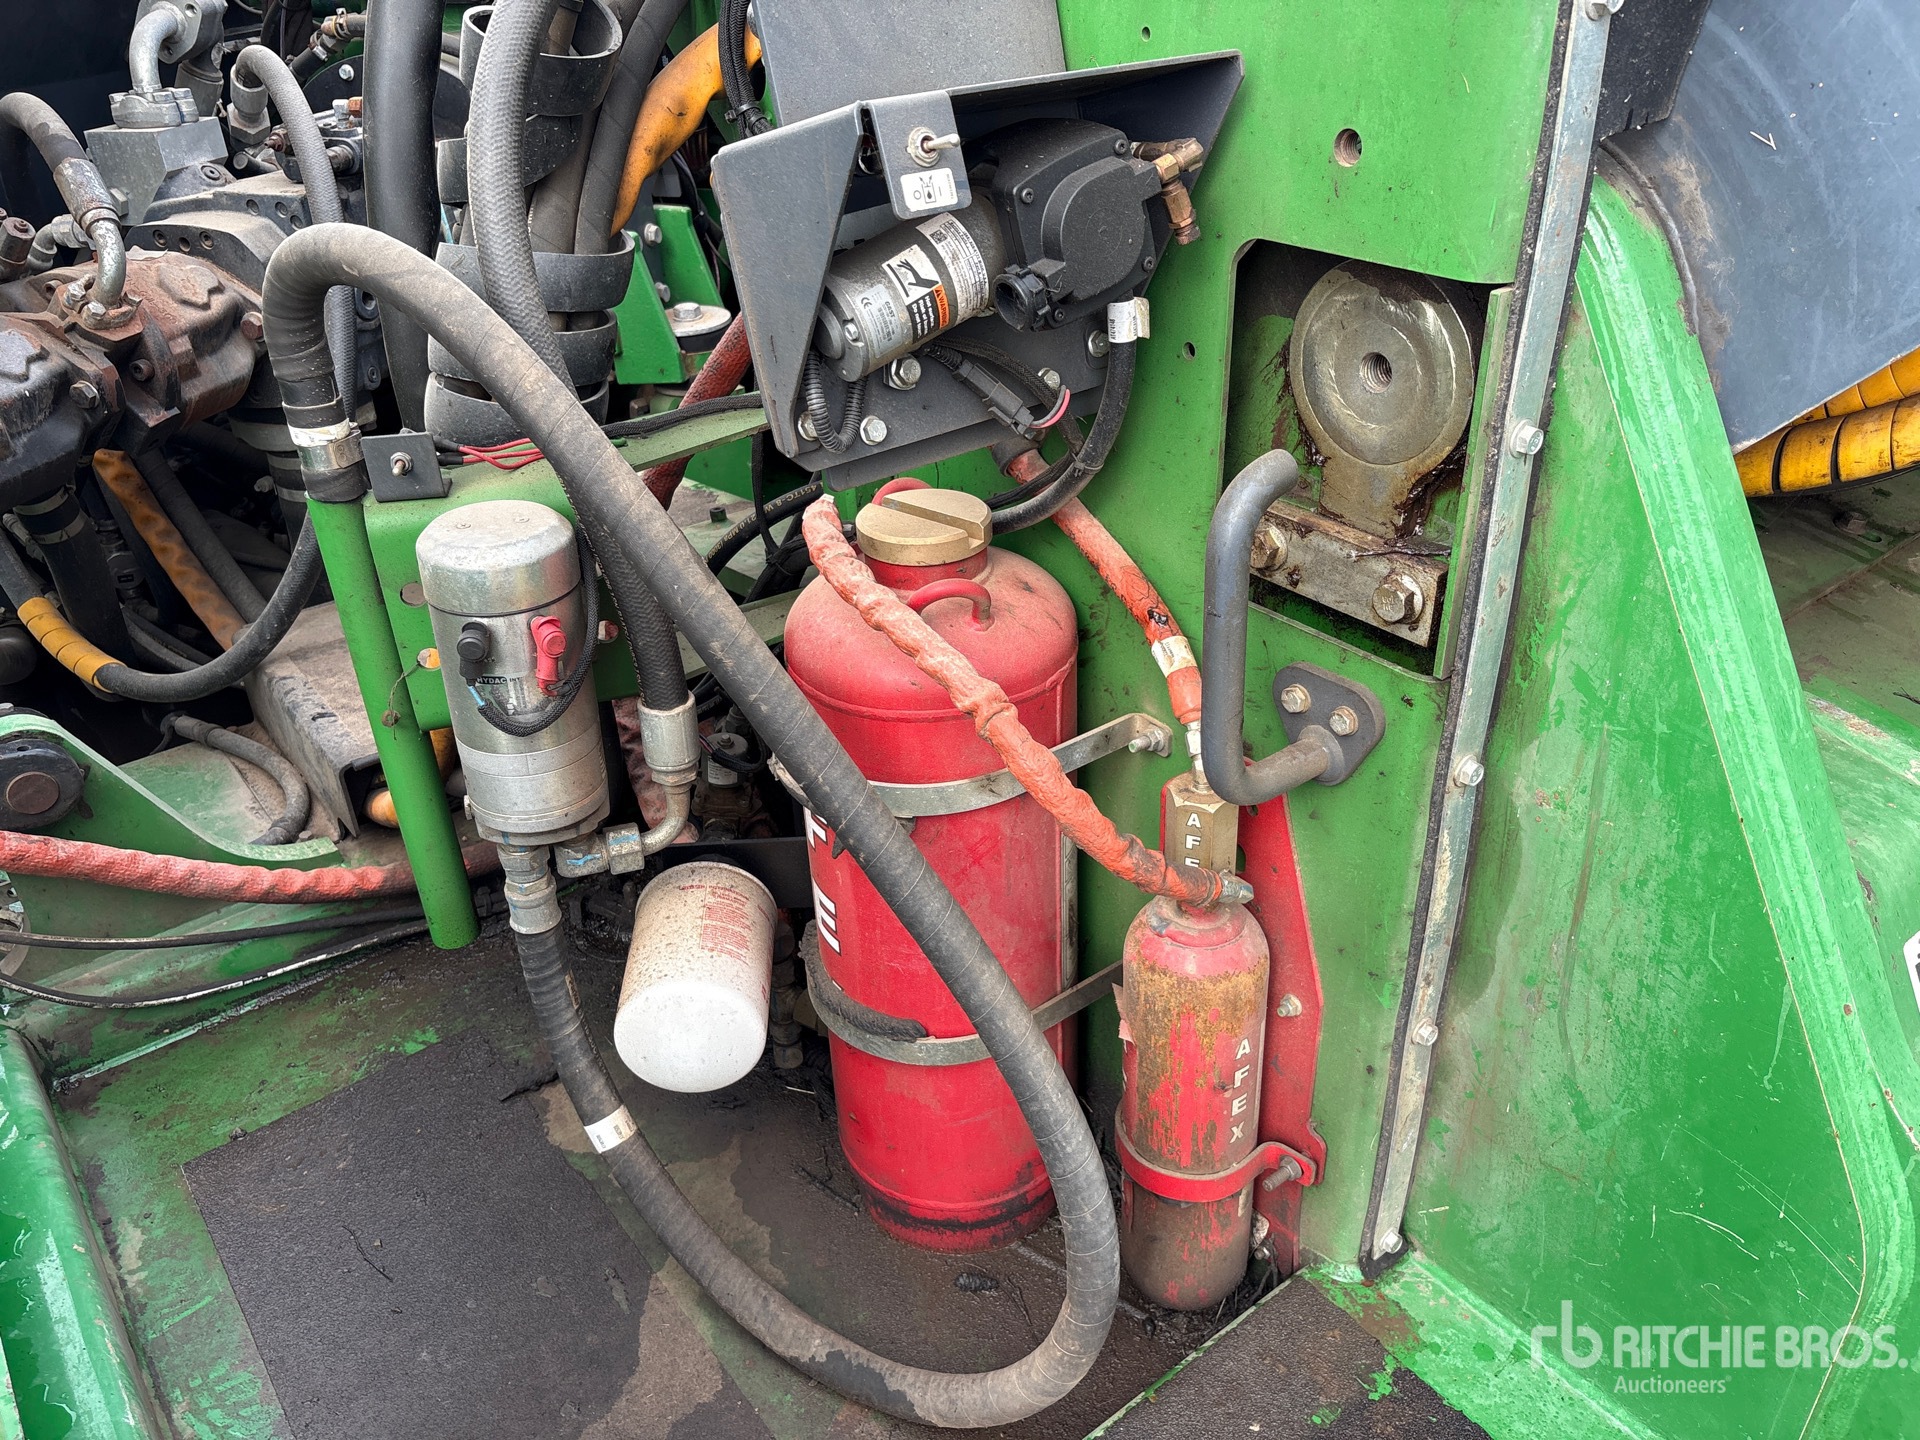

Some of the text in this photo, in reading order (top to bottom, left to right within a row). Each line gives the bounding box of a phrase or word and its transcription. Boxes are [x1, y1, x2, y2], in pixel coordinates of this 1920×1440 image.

[775, 483, 817, 507] 451TC-8
[723, 525, 739, 542] MPa
[1184, 812, 1202, 868] AFE
[1229, 1037, 1251, 1144] AFEX
